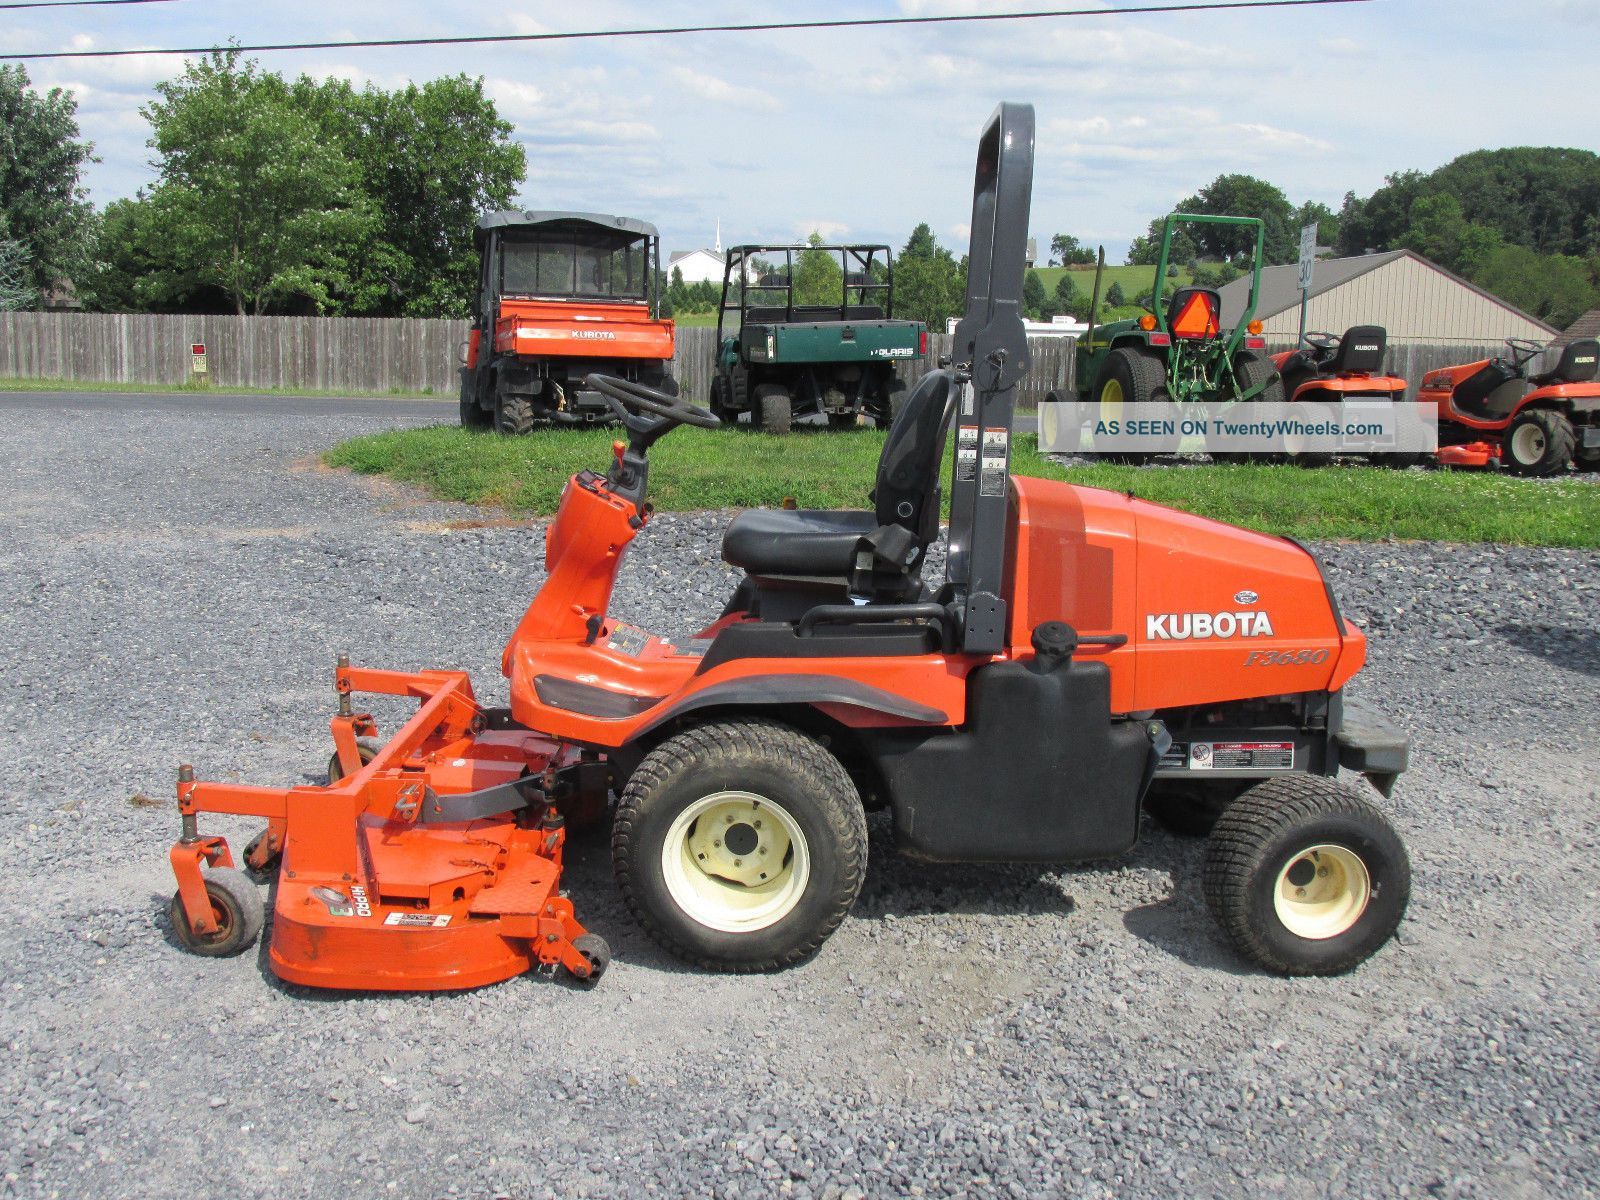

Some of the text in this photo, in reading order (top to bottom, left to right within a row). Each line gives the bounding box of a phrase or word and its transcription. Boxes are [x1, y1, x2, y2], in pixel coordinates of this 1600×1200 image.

[1299, 259, 1312, 282] 30
[571, 330, 615, 340] KUBOTA
[1146, 611, 1274, 640] KUBOTA
[1243, 649, 1329, 666] F3680
